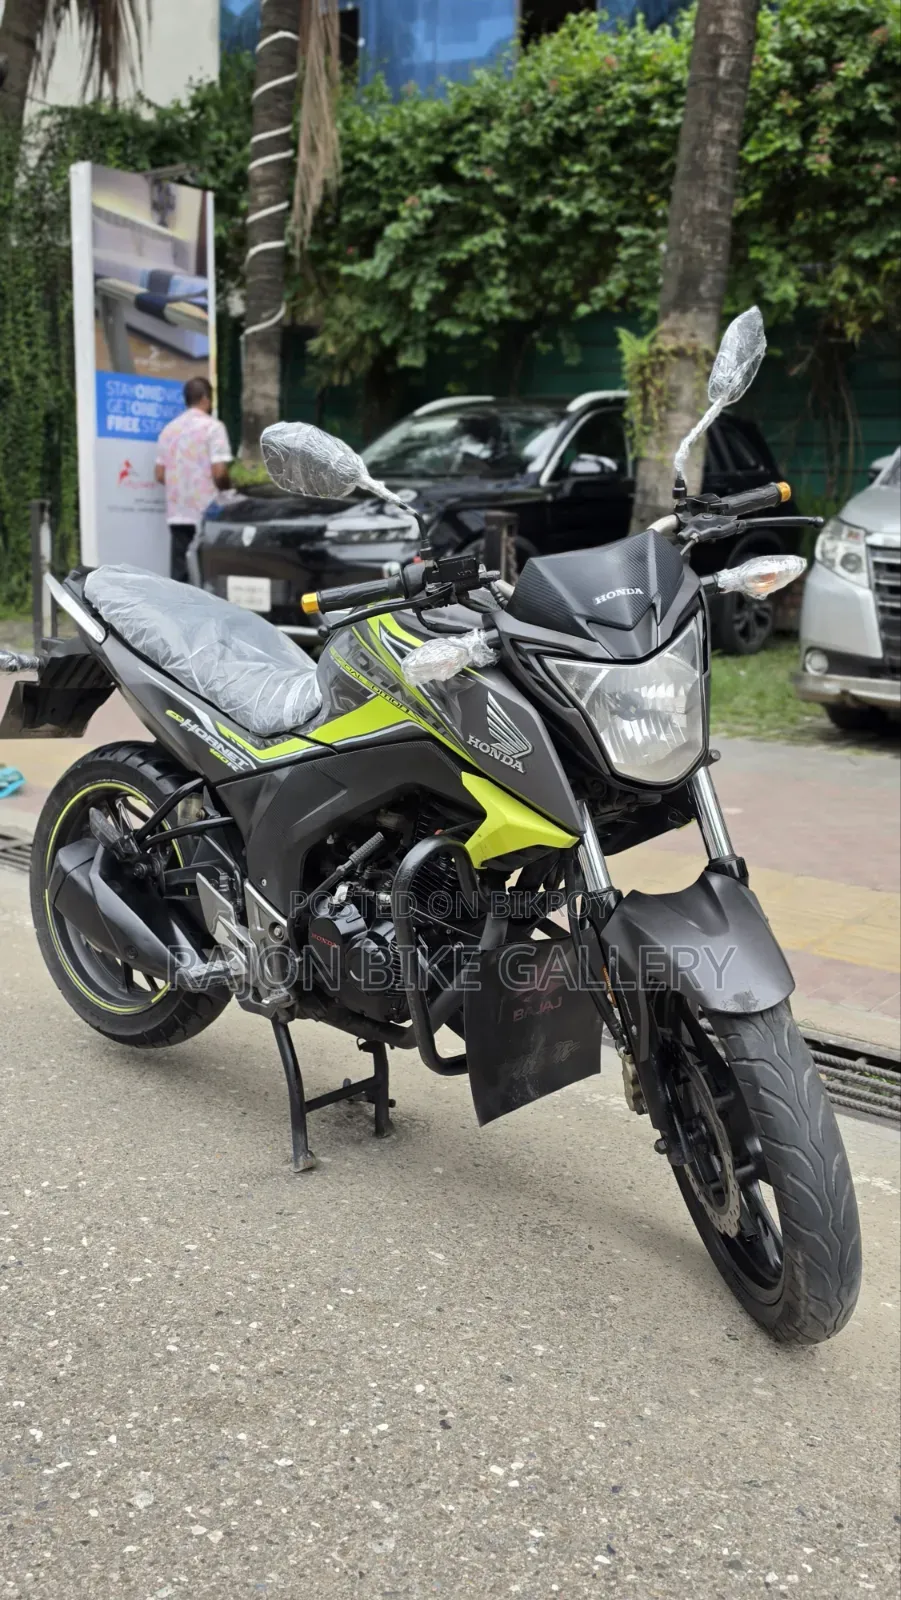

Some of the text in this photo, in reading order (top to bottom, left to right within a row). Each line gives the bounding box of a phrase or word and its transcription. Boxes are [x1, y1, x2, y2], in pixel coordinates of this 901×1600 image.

[106, 414, 140, 433] FREE
[594, 587, 645, 605] HONDA
[180, 718, 250, 768] HORNET
[466, 734, 526, 774] HONDA
[311, 932, 338, 948] HONDA
